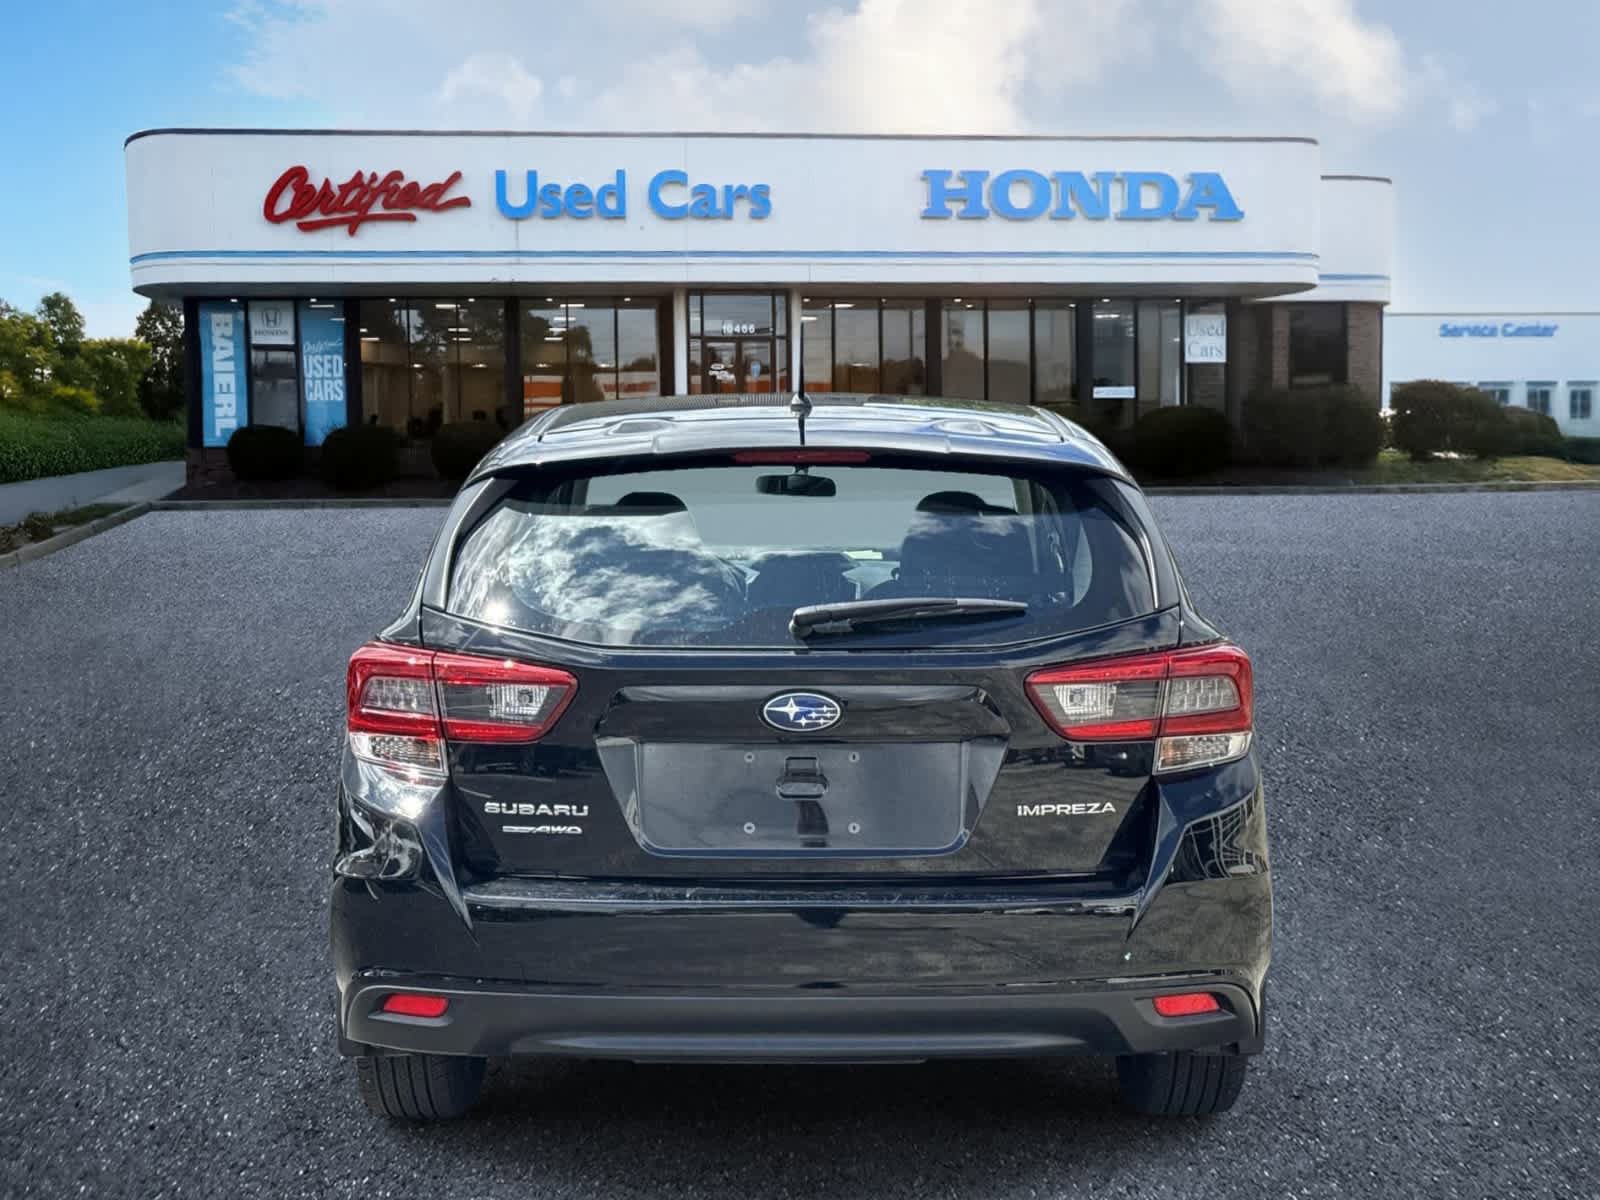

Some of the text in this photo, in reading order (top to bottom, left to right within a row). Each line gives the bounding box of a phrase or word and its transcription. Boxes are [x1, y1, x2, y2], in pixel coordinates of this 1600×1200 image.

[264, 165, 772, 236] Certified Used Cars
[920, 169, 1245, 221] HONDA
[1187, 319, 1225, 337] Used
[1439, 322, 1559, 337] Service Center
[1187, 341, 1224, 358] Cars
[211, 313, 237, 437] BAIERL
[303, 354, 343, 378] USED
[304, 379, 344, 401] CARS
[484, 802, 588, 816] SUBARU
[1017, 802, 1116, 816] IMPREZA
